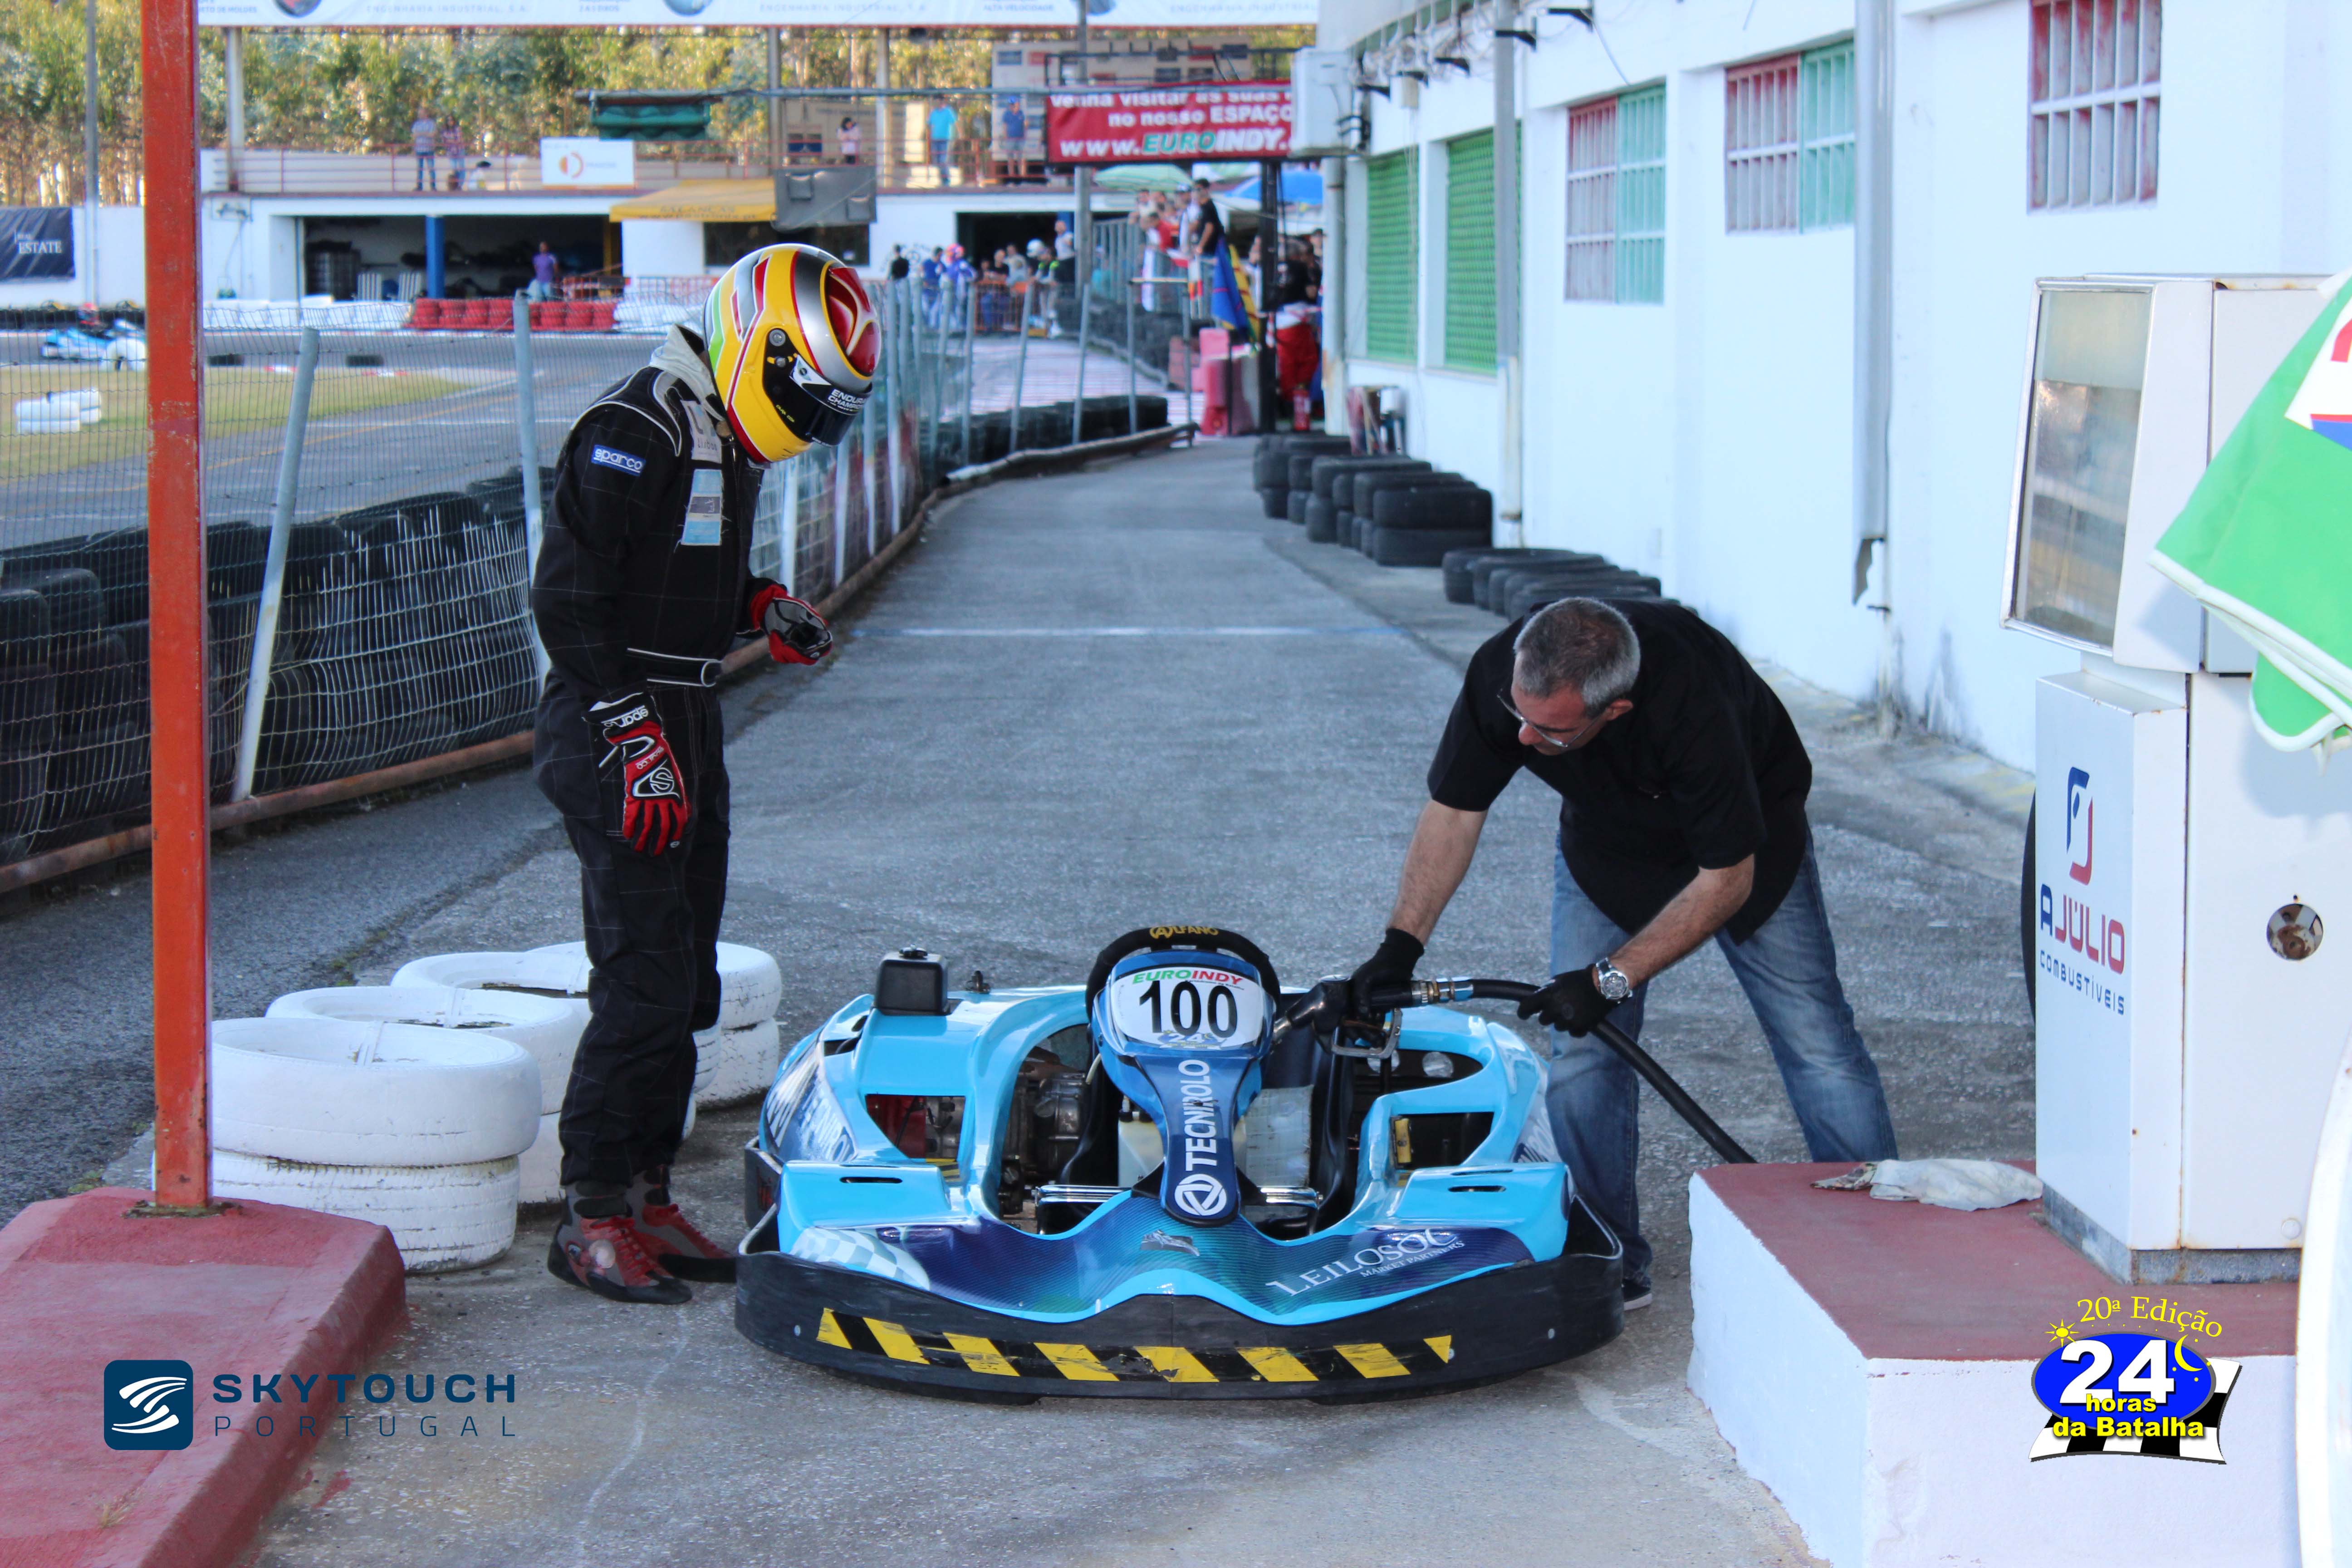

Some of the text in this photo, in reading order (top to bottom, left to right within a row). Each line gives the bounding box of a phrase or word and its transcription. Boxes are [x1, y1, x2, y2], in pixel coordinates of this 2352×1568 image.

[1107, 112, 1135, 127] no
[1140, 108, 1206, 126] nosso
[19, 241, 62, 254] ESTATE
[594, 447, 643, 472] sparco
[2040, 950, 2124, 1016] COMBUSTÍVEIS
[1139, 980, 1238, 1039] 100
[1178, 1059, 1217, 1172] TECNIROLO
[1360, 1240, 1465, 1278] MARKET PARTNERS
